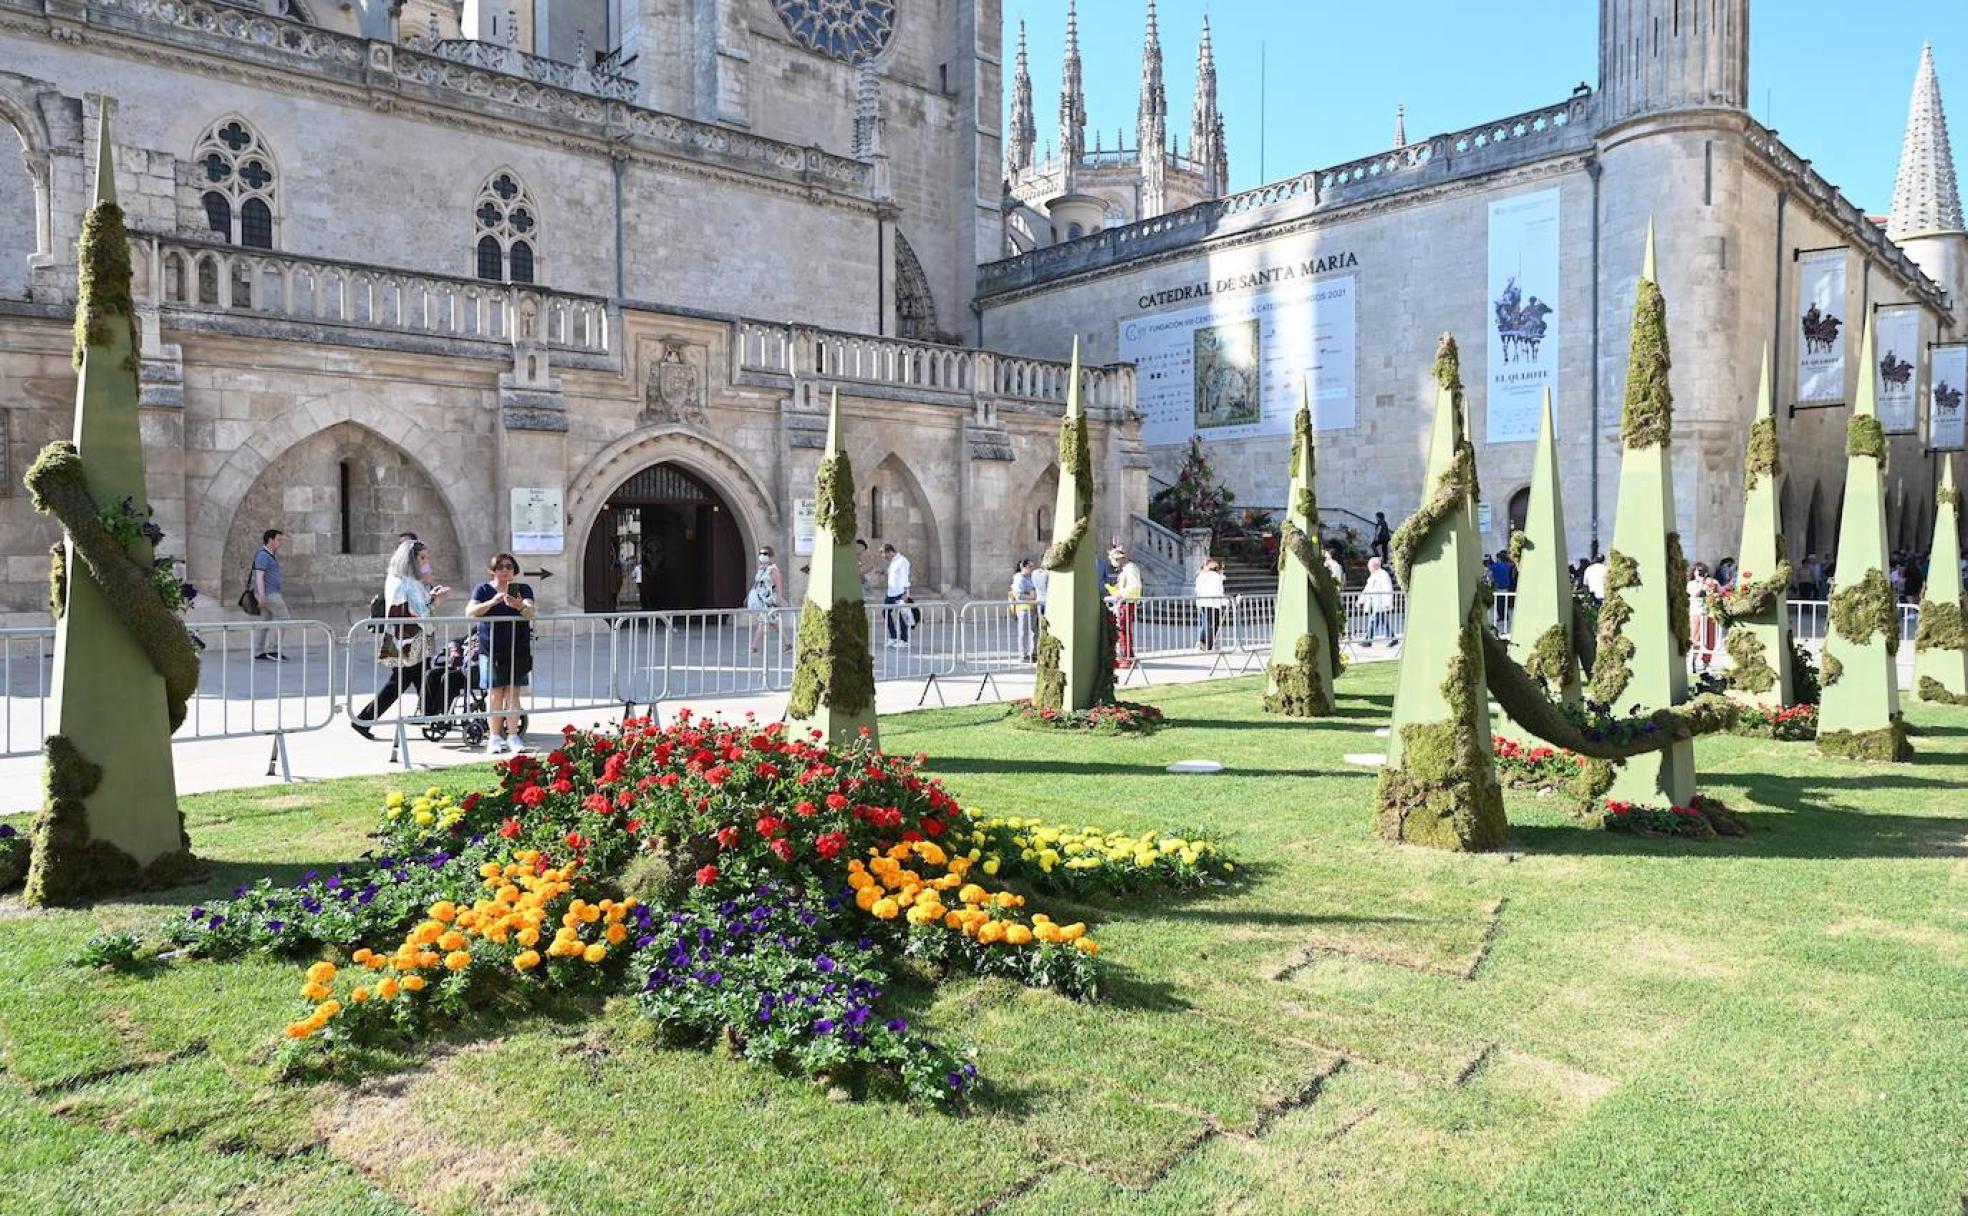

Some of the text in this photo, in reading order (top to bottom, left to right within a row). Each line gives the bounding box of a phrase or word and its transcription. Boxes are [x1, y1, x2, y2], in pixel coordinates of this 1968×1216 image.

[1138, 252, 1359, 309] CATEDRAL DE SANTA MARÍA
